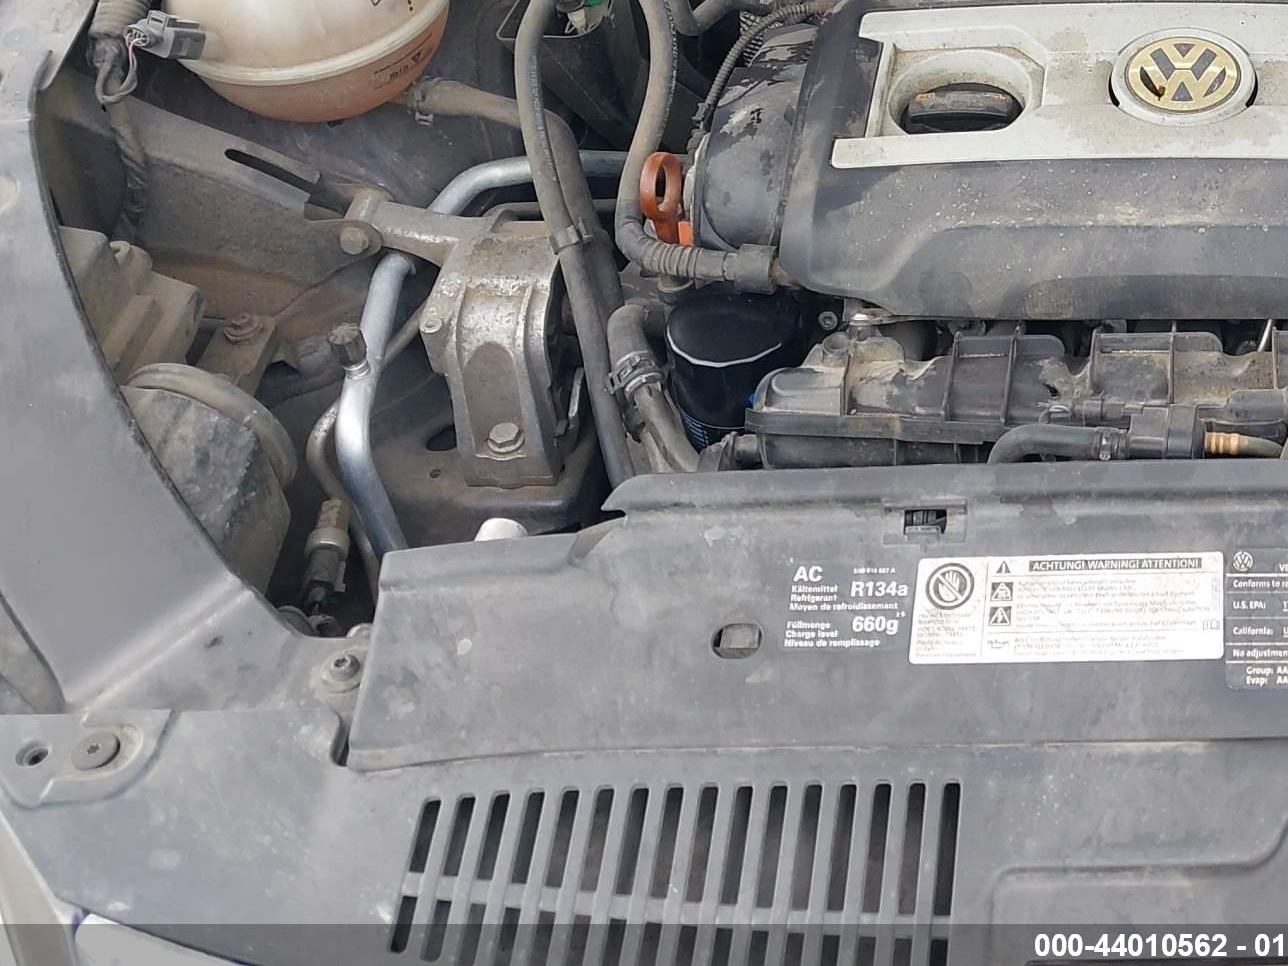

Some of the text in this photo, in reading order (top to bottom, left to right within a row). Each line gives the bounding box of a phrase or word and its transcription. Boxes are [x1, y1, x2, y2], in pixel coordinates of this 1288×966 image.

[1032, 558, 1199, 570] ACHTUNG! WARNING! ATTENTION!
[793, 565, 823, 582] AC
[1233, 580, 1269, 588] Conforms
[791, 585, 838, 593] Kältemittel
[850, 581, 908, 597] R134a
[790, 594, 837, 603] Refrigerant
[789, 603, 818, 611] Moyen
[833, 602, 898, 610] refroidissement
[1233, 601, 1248, 609] U.S.
[1249, 601, 1266, 609] EPA:
[787, 621, 831, 630] Füllmenge
[852, 616, 899, 635] 660g
[785, 630, 815, 639] Charge
[1233, 627, 1273, 635] California:
[829, 639, 880, 648] remplissage
[1233, 649, 1244, 657] No
[1246, 666, 1273, 676] Group:
[1246, 676, 1268, 685] Evap:
